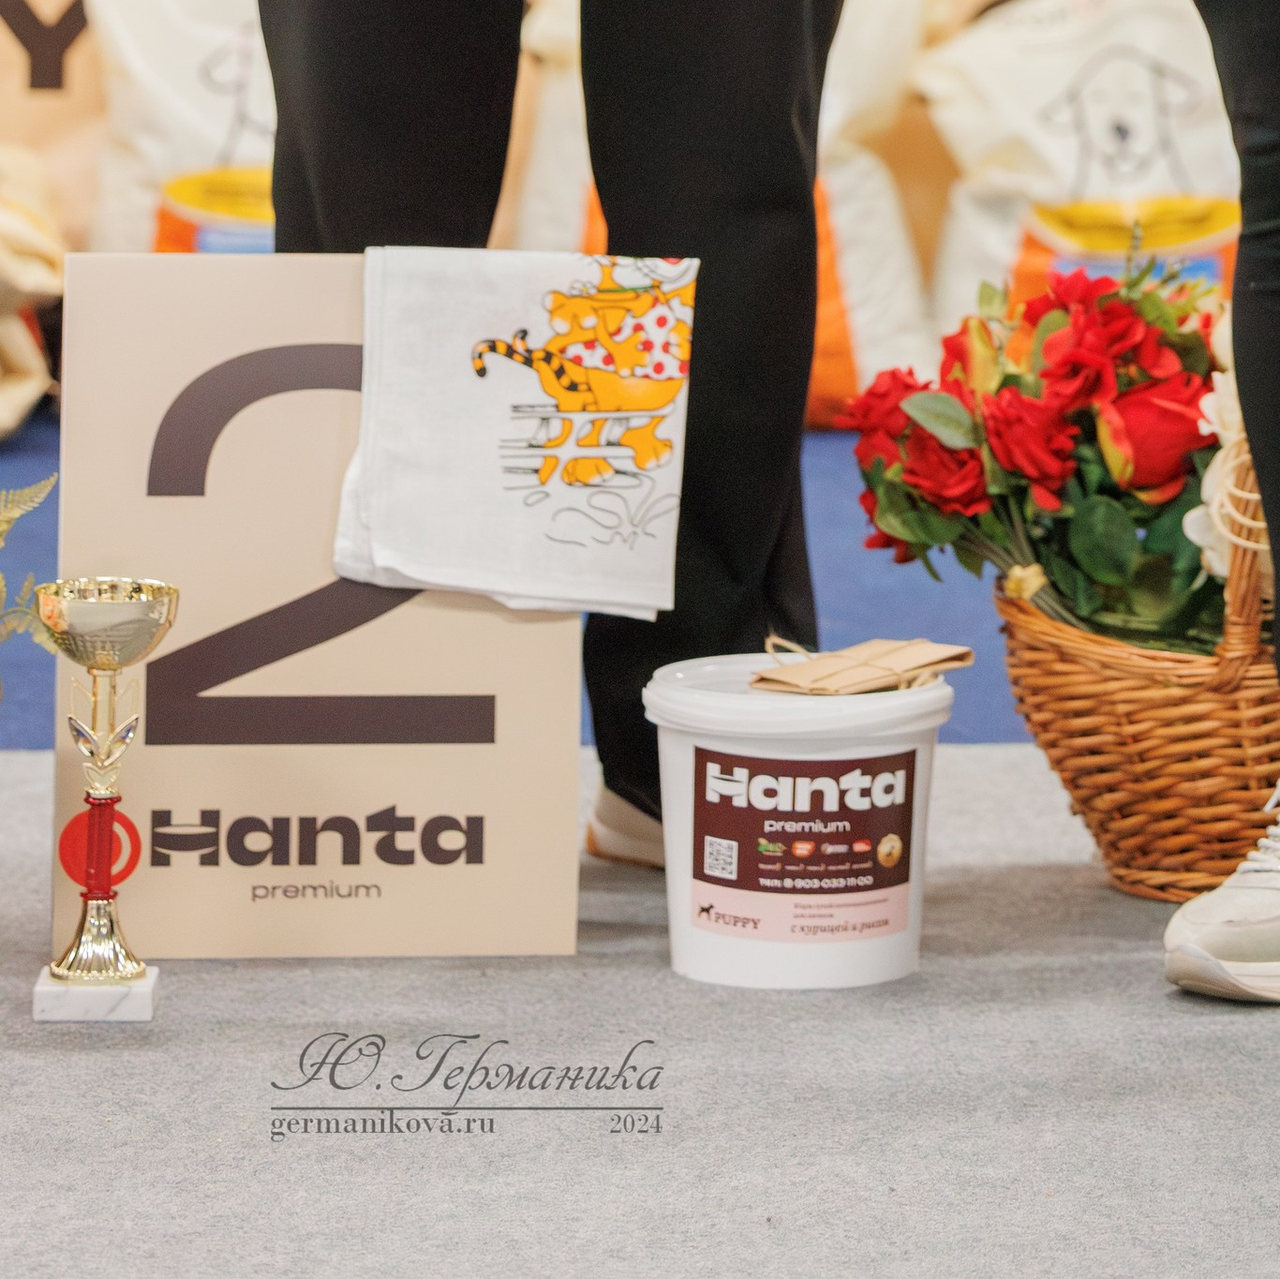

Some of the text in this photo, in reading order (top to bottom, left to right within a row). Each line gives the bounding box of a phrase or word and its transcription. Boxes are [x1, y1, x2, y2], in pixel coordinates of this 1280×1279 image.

[145, 342, 497, 745] 2
[706, 761, 907, 813] Hanta
[150, 804, 485, 867] Hanta
[763, 819, 851, 834] premium
[250, 879, 382, 902] premium
[713, 911, 761, 930] PUPPY
